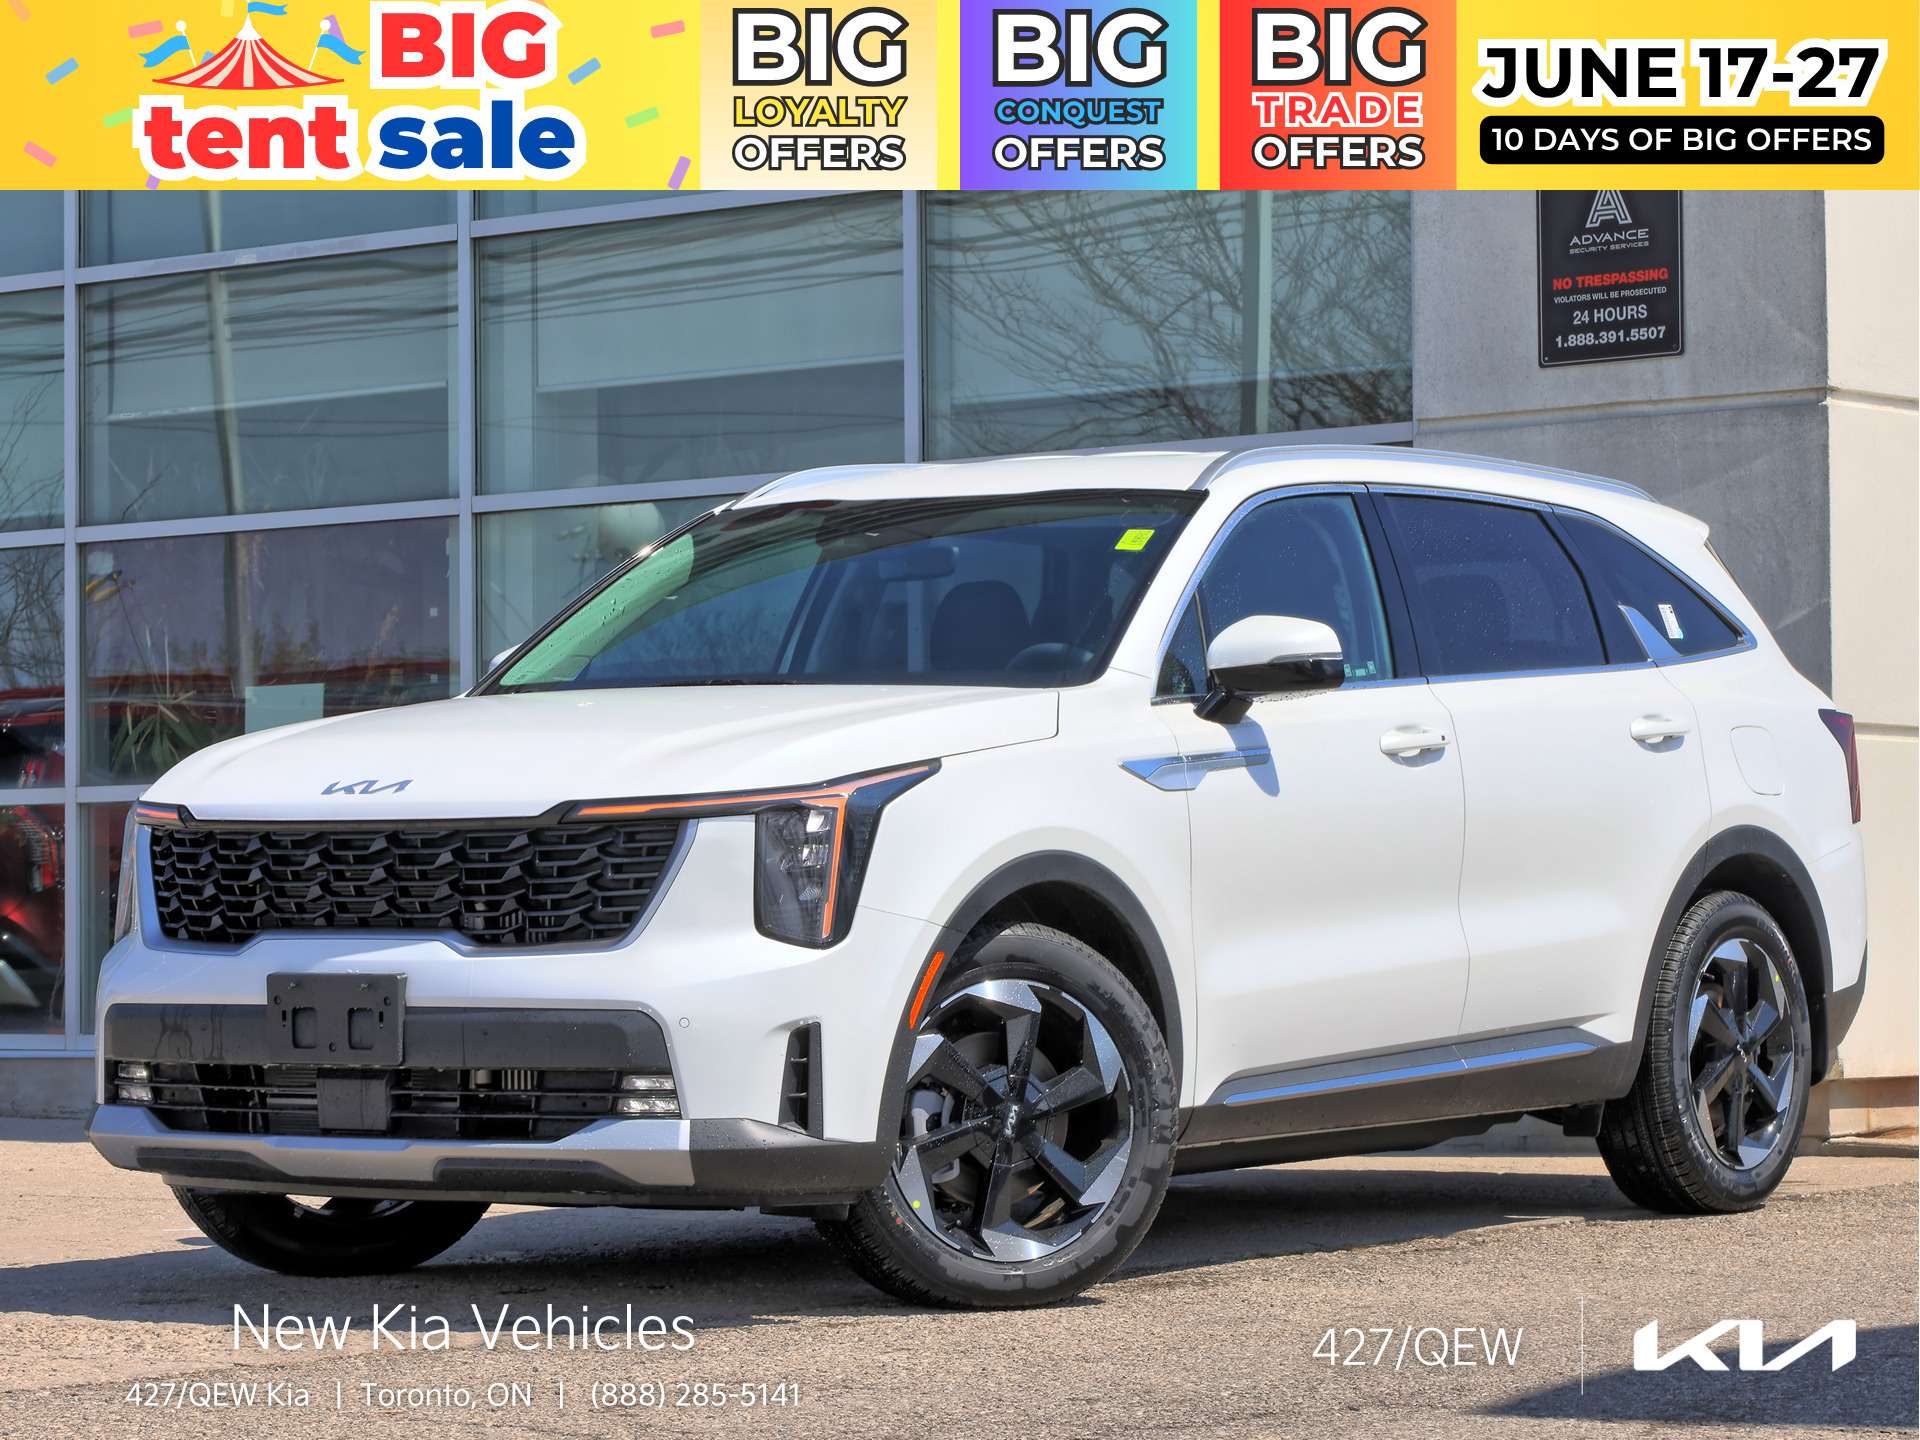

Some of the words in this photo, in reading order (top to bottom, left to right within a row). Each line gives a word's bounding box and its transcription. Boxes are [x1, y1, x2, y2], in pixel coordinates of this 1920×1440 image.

[1569, 228, 1649, 246] ADVANCE
[1569, 244, 1608, 255] SECURITY
[1610, 240, 1649, 250] SERVICES
[1552, 277, 1572, 291] NO
[1575, 267, 1669, 288] TRESPASSING
[1553, 293, 1592, 304] VIOLATORS
[1592, 291, 1609, 300] WILL
[1610, 290, 1620, 299] BE
[1620, 286, 1667, 298] PROSECUTED
[1573, 309, 1590, 325] 24
[1593, 304, 1648, 323] HOURS
[1555, 325, 1667, 349] 1.888.391.5507
